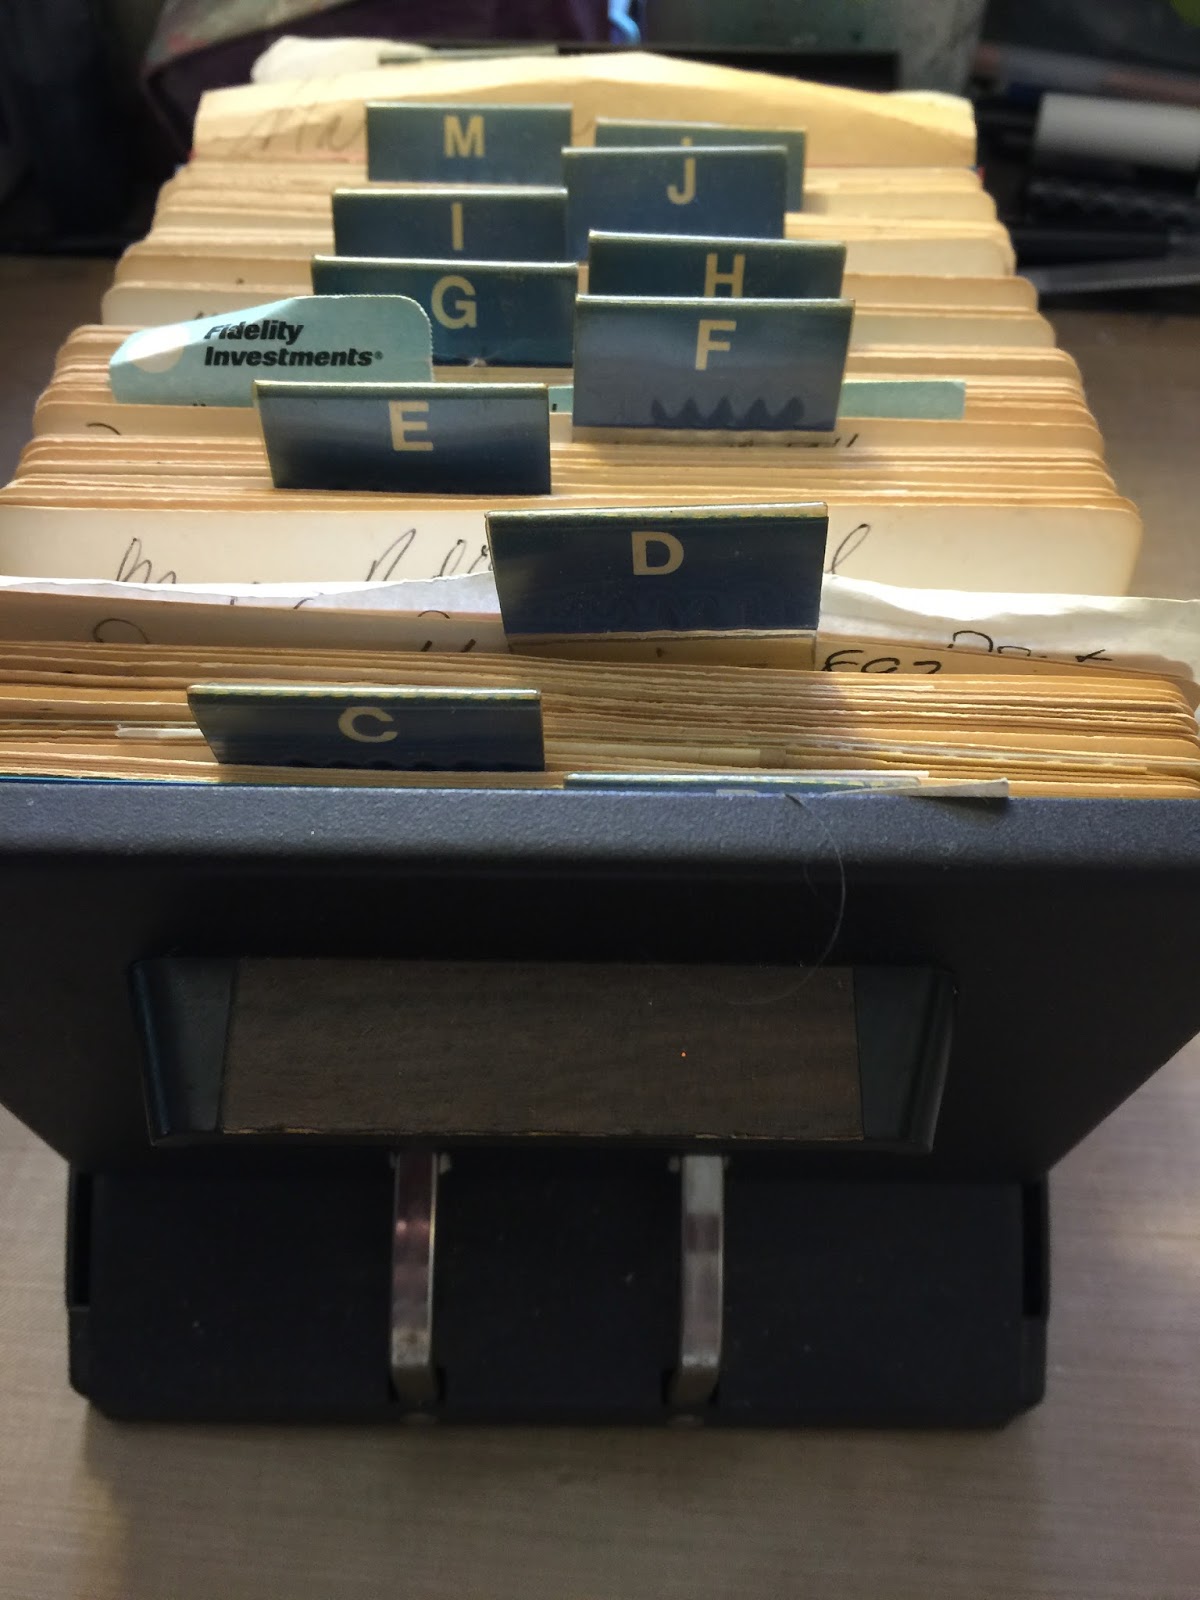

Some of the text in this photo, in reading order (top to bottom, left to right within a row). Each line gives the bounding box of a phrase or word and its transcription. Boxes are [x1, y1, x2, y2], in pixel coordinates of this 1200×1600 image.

[444, 114, 485, 157] M
[667, 156, 696, 205] J
[451, 201, 464, 251] I
[703, 251, 746, 297] H
[431, 274, 478, 329] G
[204, 319, 304, 345] Fidelity
[695, 319, 737, 371] F
[388, 400, 434, 451] E
[631, 531, 685, 576] D
[338, 706, 398, 743] C
